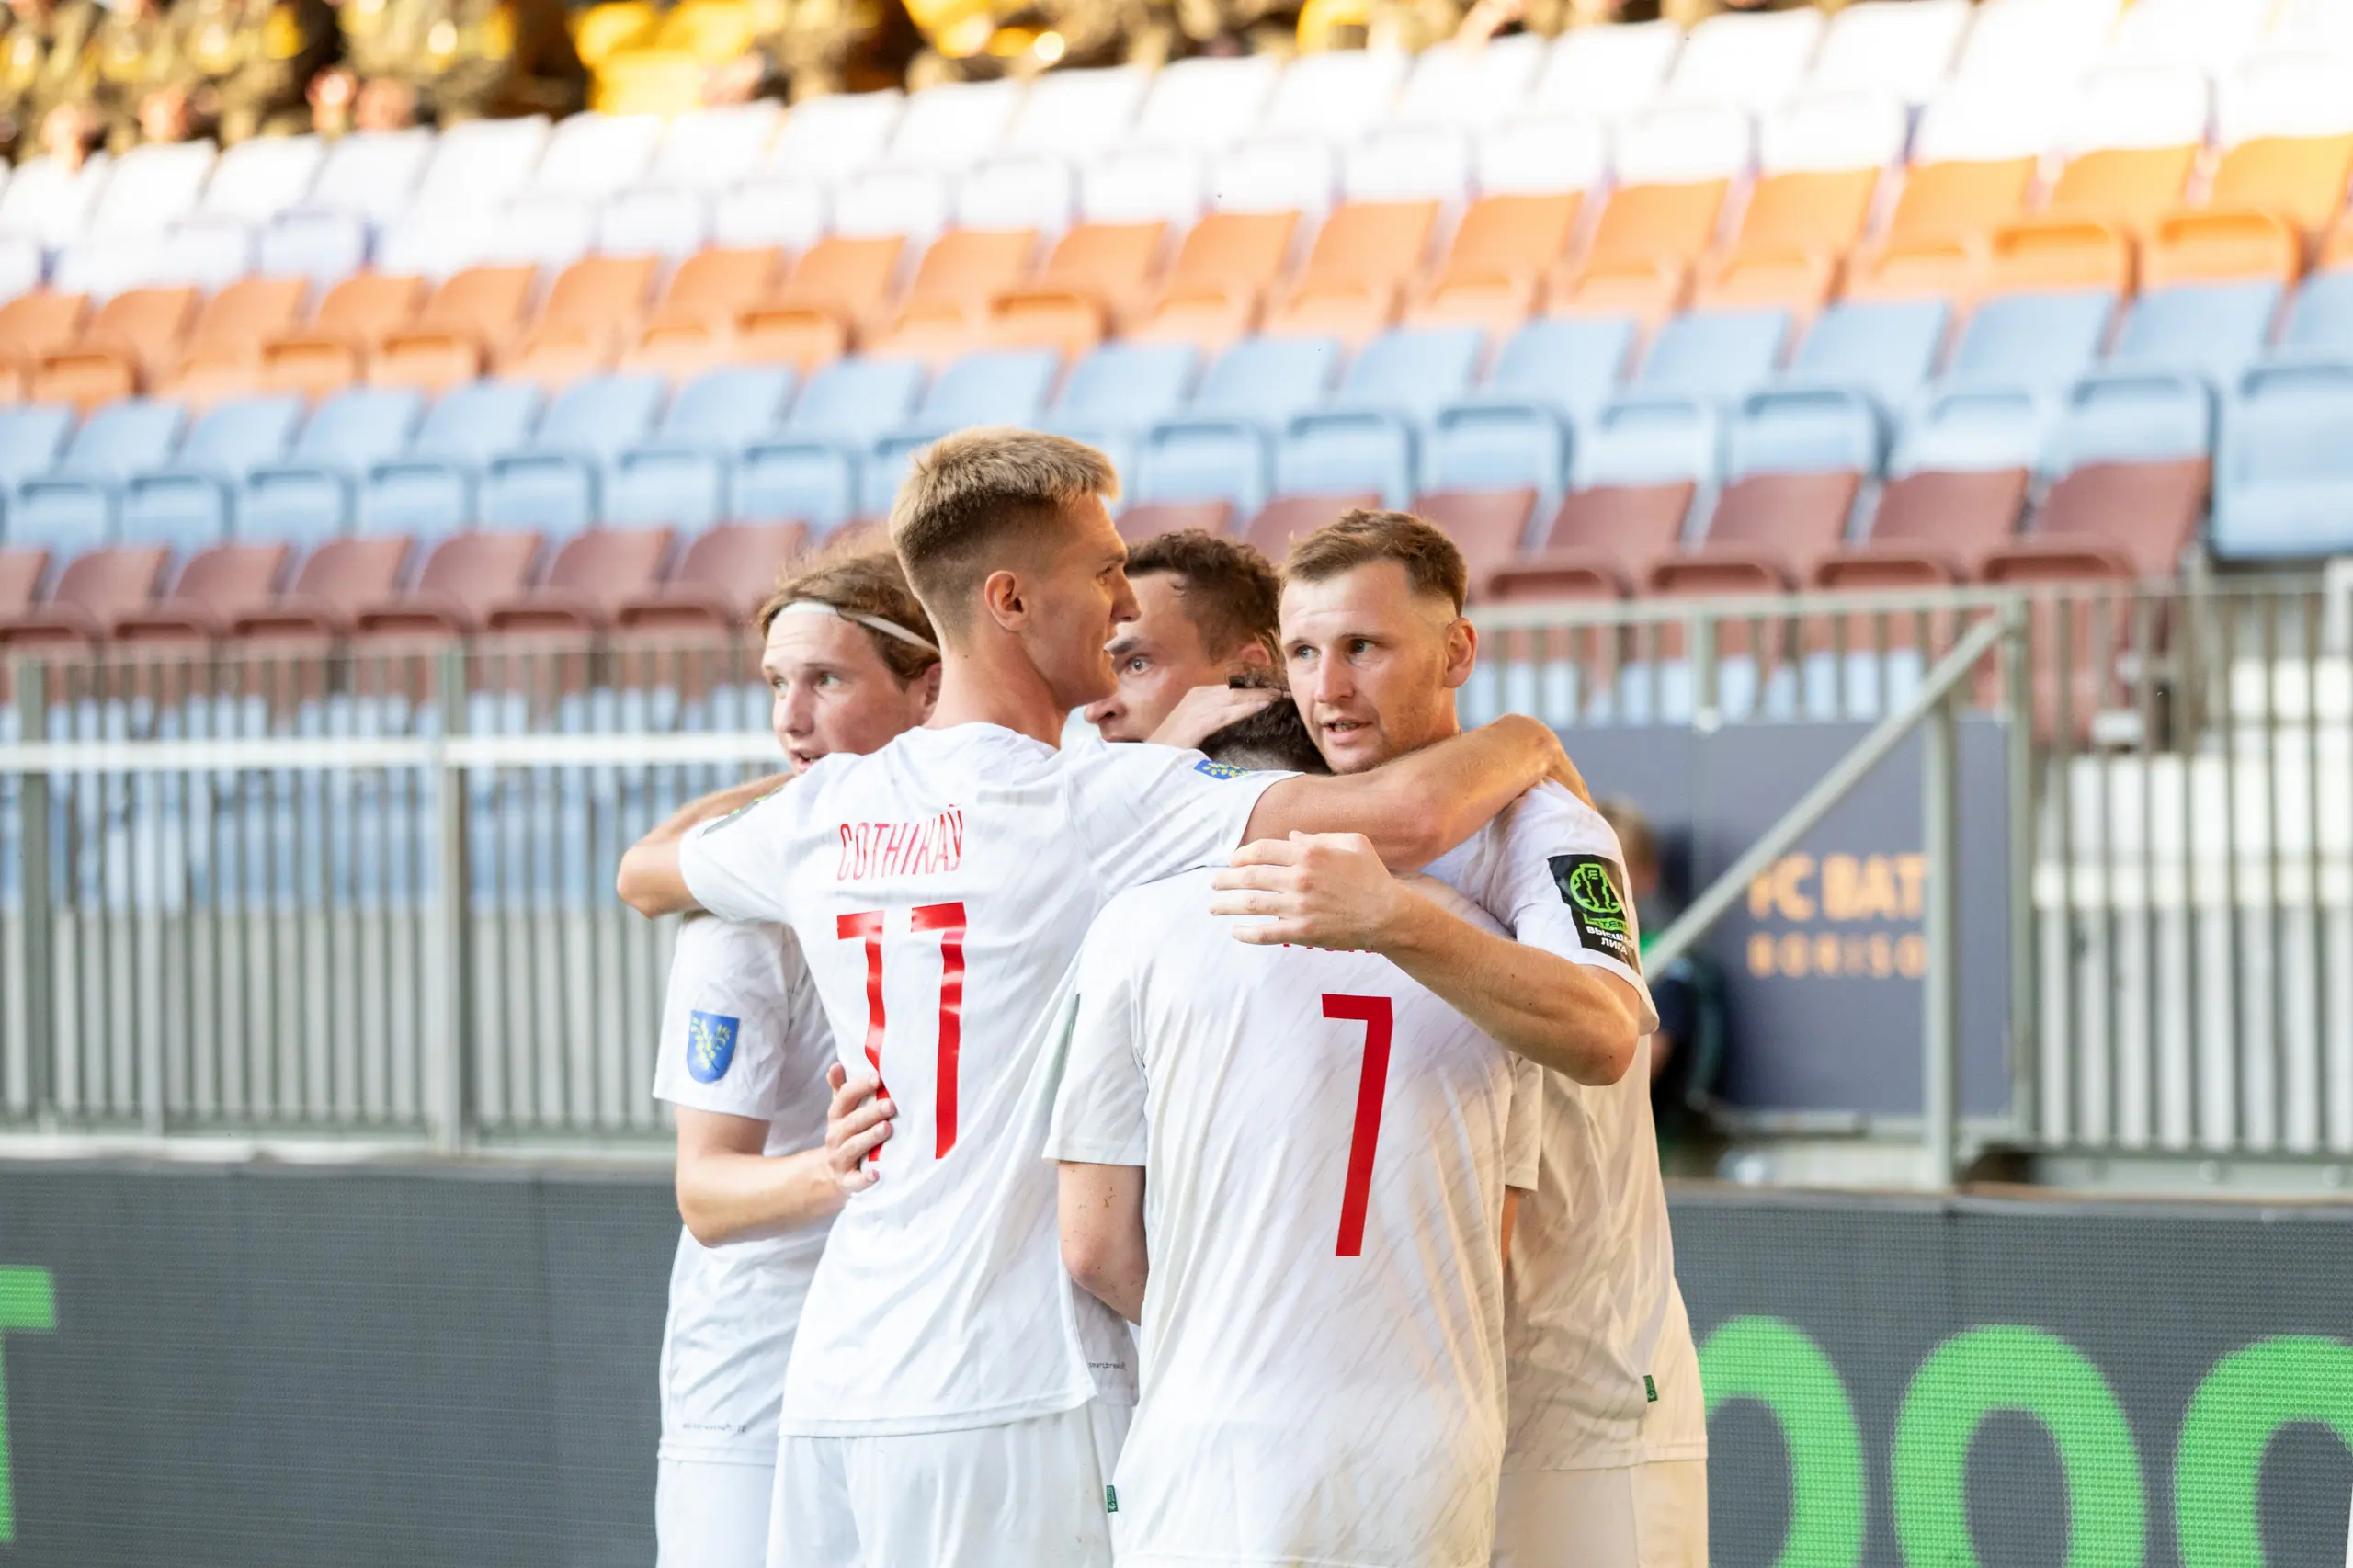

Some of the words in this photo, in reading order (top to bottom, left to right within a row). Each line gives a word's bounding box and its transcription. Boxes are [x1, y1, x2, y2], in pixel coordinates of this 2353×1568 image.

[1747, 851, 1816, 922] FC
[1821, 851, 1928, 922] BAT
[1748, 930, 1929, 980] BORISO
[1322, 994, 1393, 1256] 7
